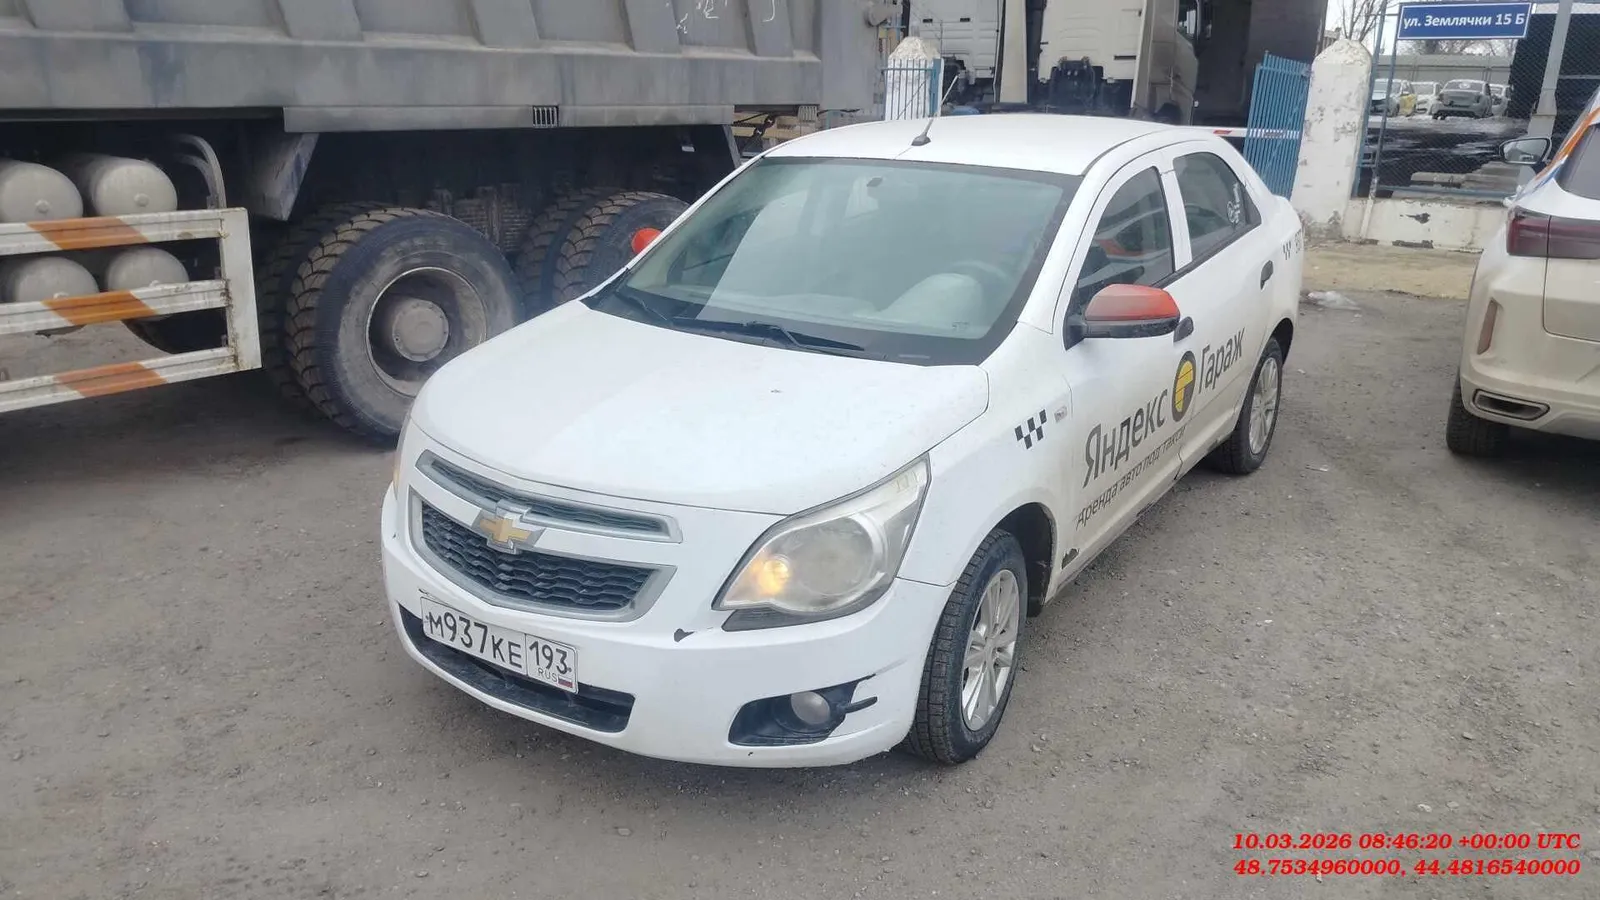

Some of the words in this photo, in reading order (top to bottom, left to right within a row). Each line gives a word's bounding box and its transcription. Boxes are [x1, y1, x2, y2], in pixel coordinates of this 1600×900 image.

[1403, 18, 1421, 29] ул.
[1424, 15, 1492, 27] Землячки
[1495, 13, 1512, 25] 15
[1515, 13, 1525, 25] Б
[1083, 388, 1168, 489] Яндекс
[1199, 327, 1246, 394] Гараж
[1076, 481, 1118, 531] Аренда
[1119, 461, 1143, 492] авто
[1143, 445, 1163, 472] под
[1162, 425, 1187, 453] такси
[529, 641, 568, 675] 193
[538, 667, 557, 683] RUS
